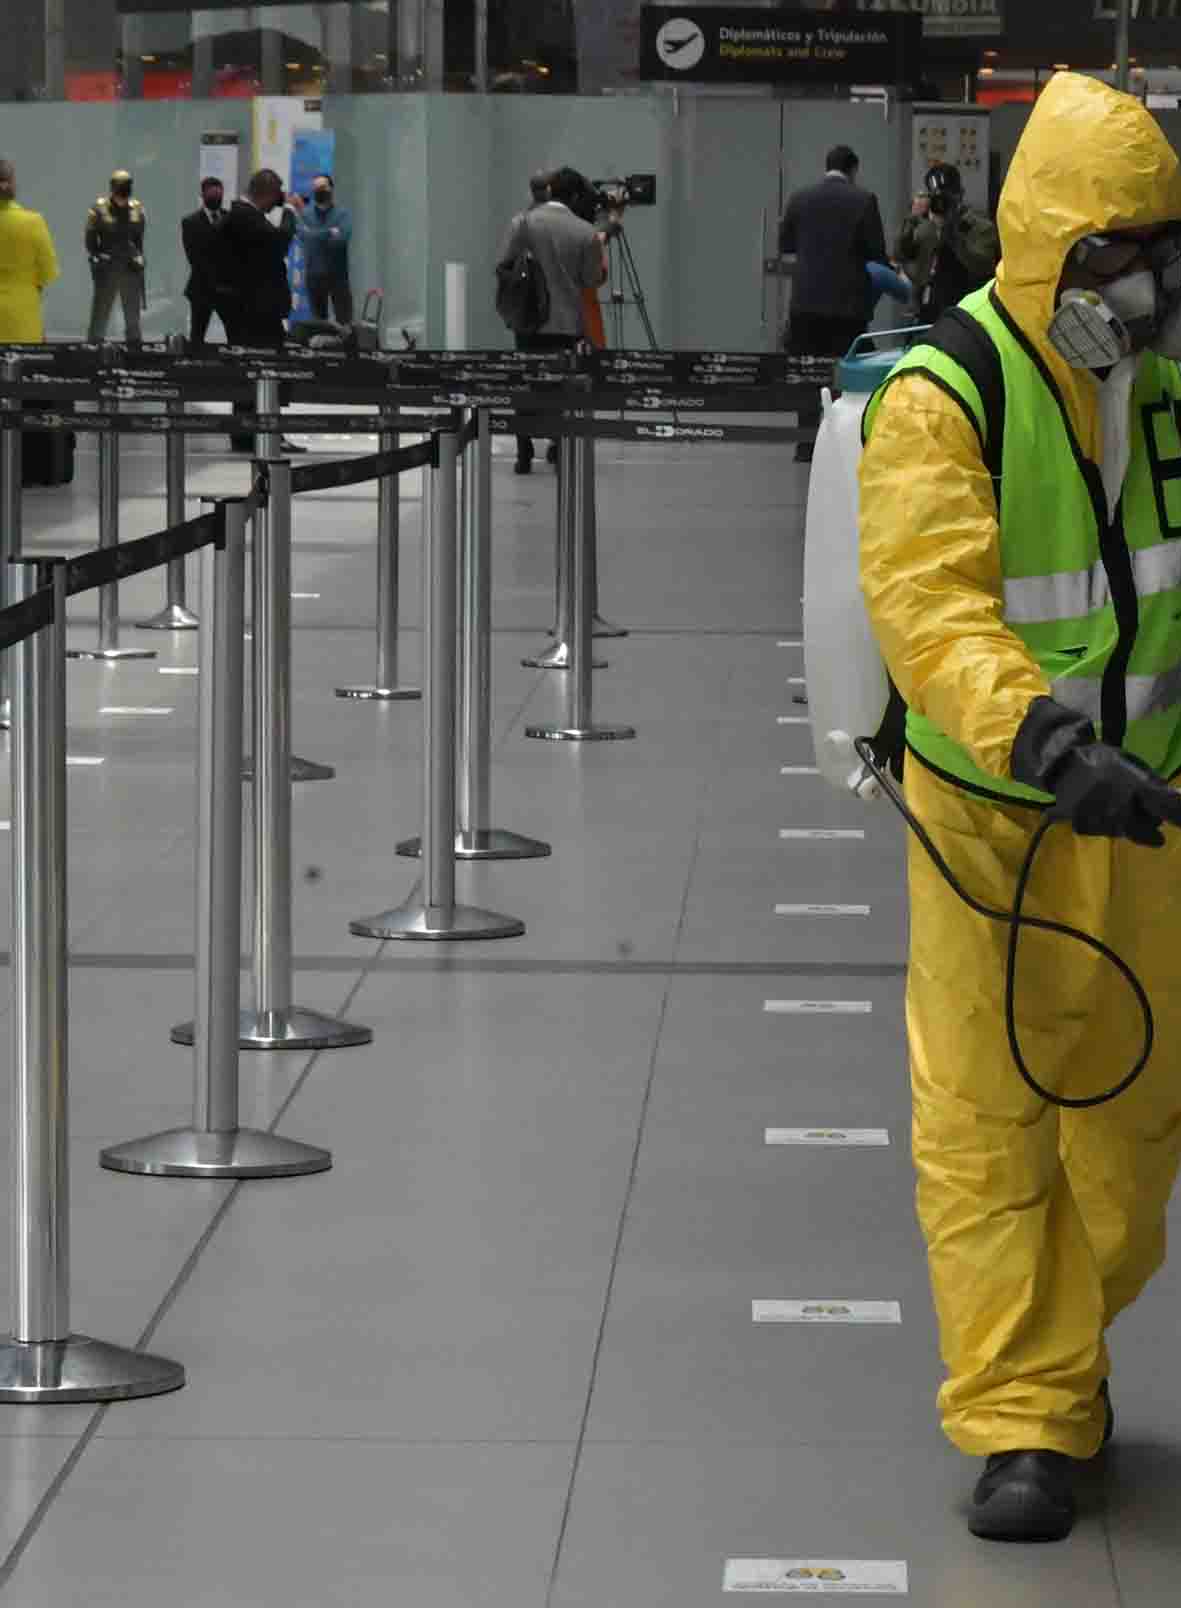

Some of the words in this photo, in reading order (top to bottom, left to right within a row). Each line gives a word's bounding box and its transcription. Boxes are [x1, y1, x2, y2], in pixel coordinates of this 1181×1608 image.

[719, 24, 801, 44] Diplomáticos
[804, 32, 814, 47] y
[816, 24, 889, 44] Tripulación
[719, 44, 784, 59] Diplomats
[786, 45, 812, 58] and
